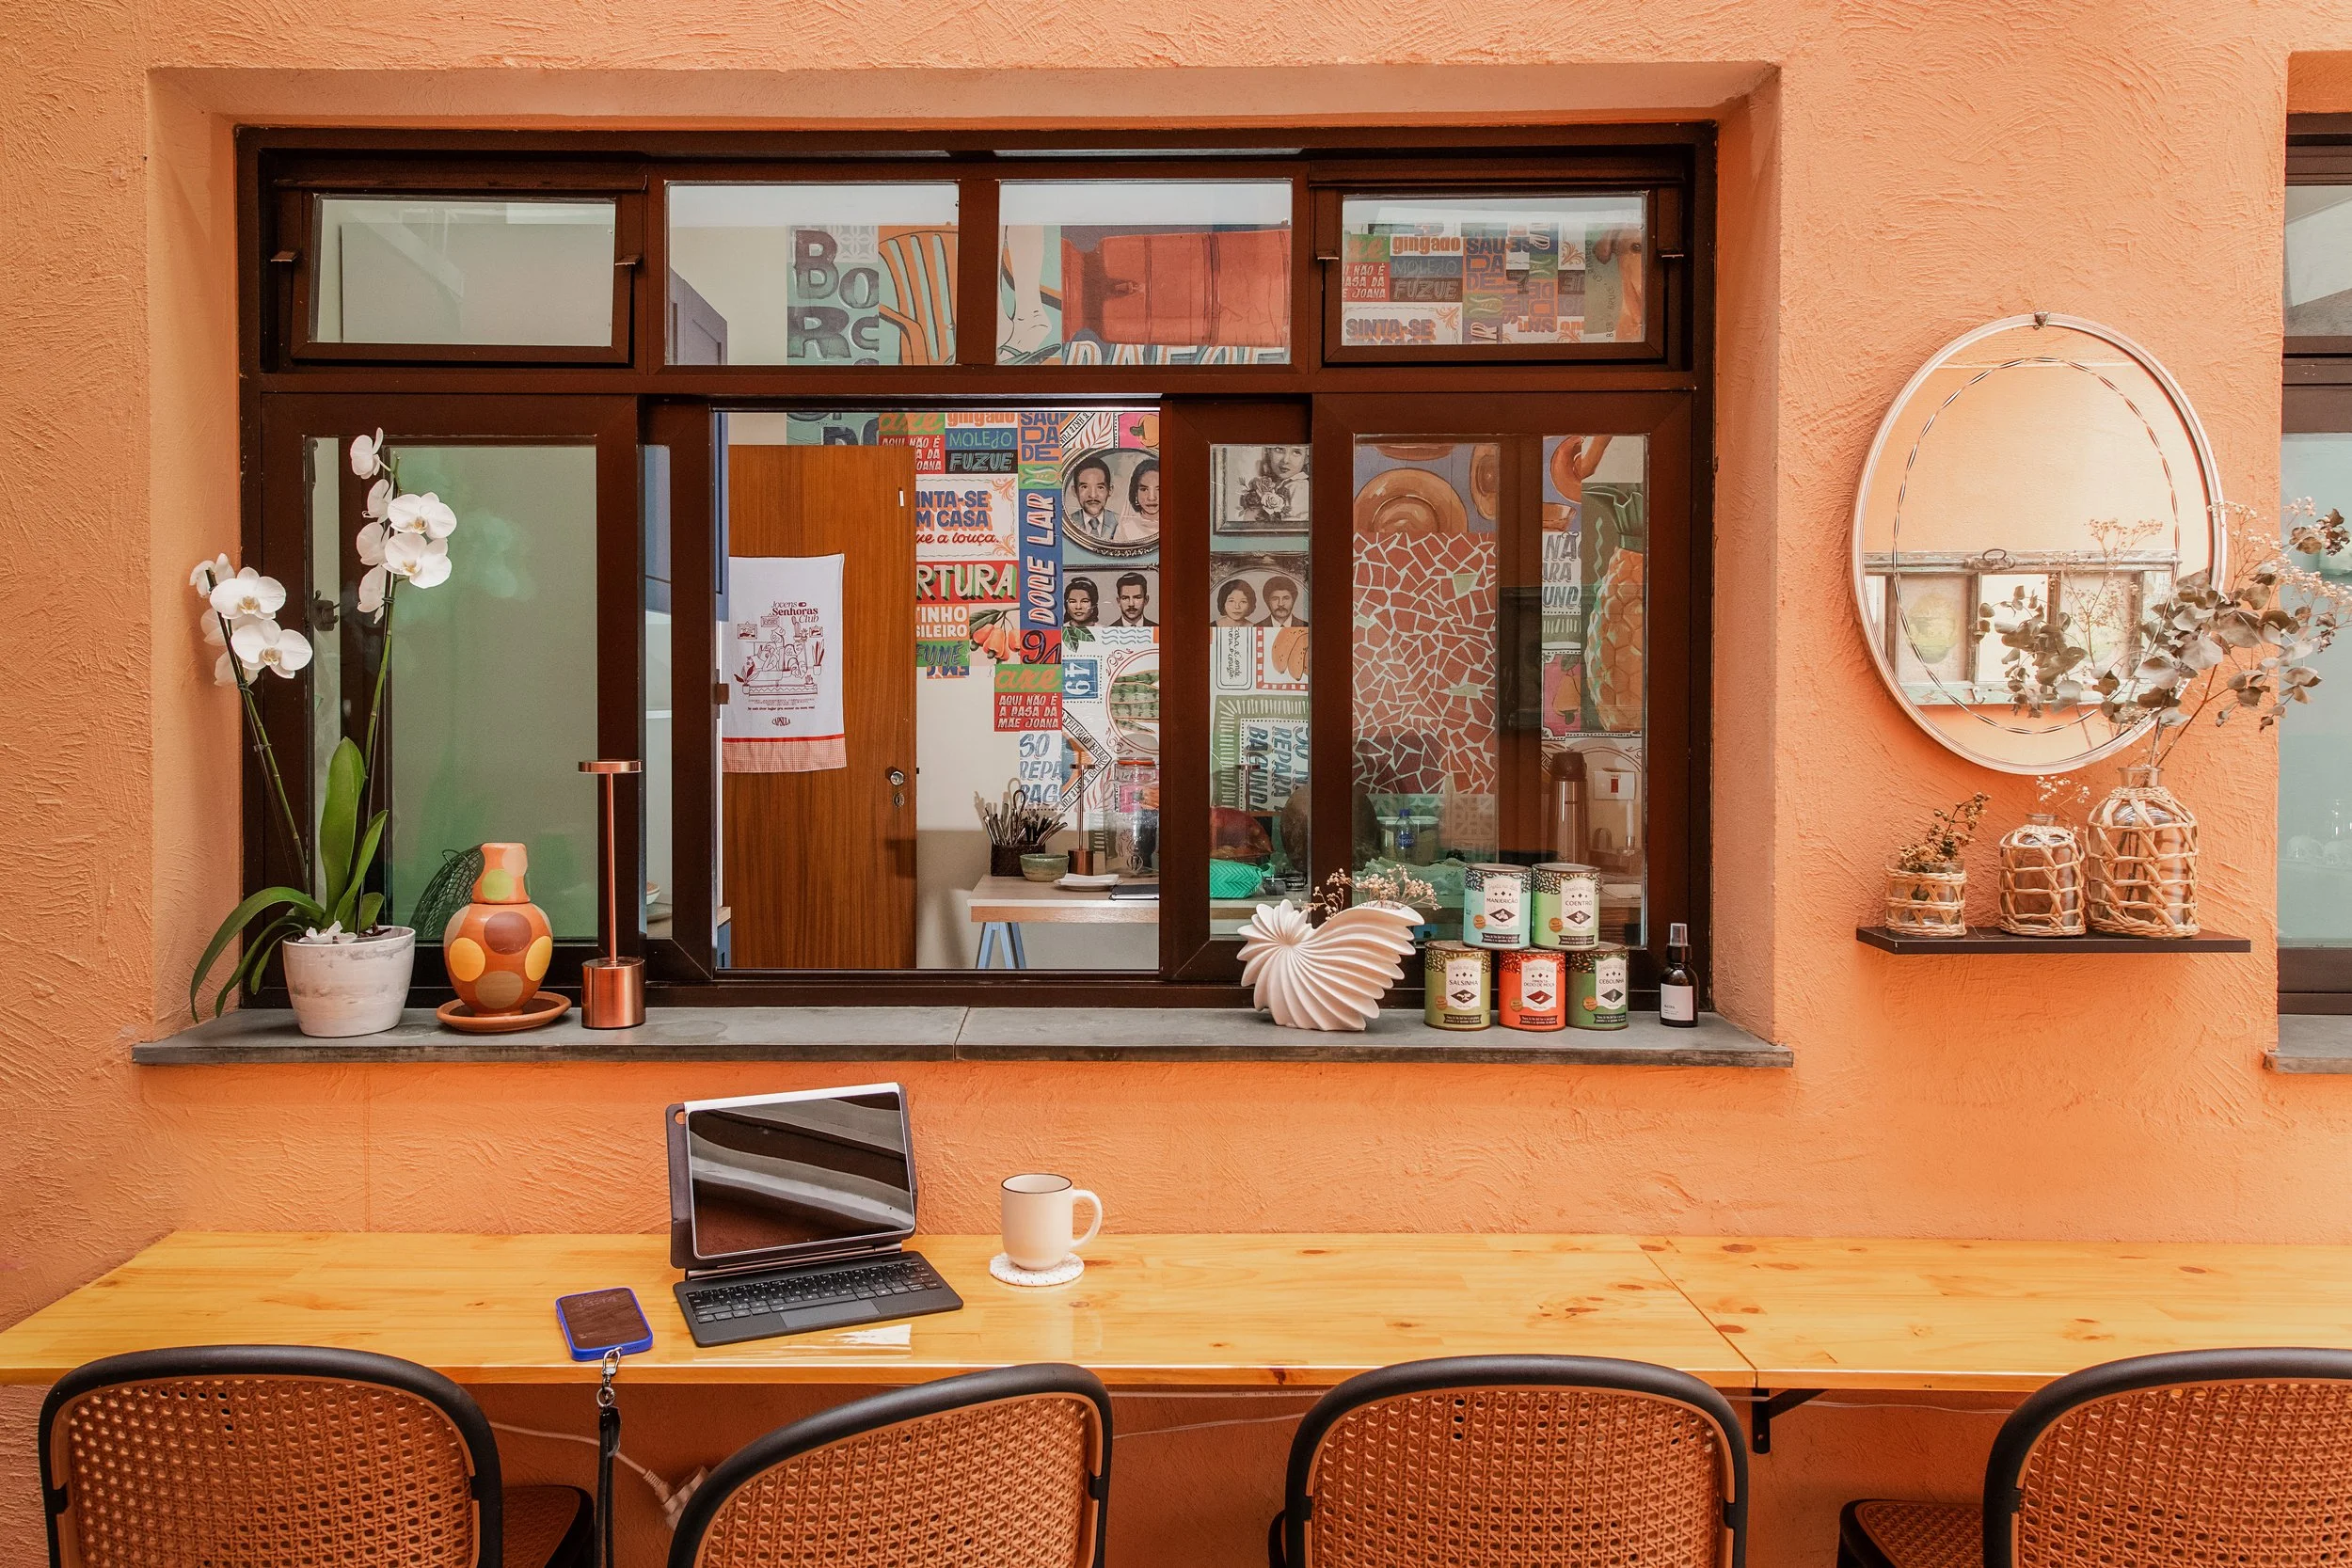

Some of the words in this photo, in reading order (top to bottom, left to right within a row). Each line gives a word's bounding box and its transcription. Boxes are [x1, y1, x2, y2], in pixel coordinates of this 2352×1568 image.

[1392, 235, 1460, 255] gingado
[1343, 277, 1367, 287] ASA
[1352, 288, 1386, 298] JOANA
[1345, 318, 1436, 340] SINTA-SE
[1021, 426, 1059, 444] DA
[1021, 444, 1059, 461] DE
[915, 461, 941, 471] OANA
[937, 511, 991, 530] CASA
[1026, 492, 1056, 547] LAR
[1544, 531, 1581, 561] NÃ
[771, 608, 818, 616] Senhoras
[798, 615, 819, 624] Club
[999, 695, 1023, 705] AQUI
[1026, 694, 1046, 705] NÃO
[1050, 692, 1058, 705] É
[999, 705, 1007, 716] A
[1043, 705, 1057, 716] DA
[998, 716, 1022, 727] MÃE
[1025, 718, 1059, 727] JOANA
[1272, 725, 1292, 798] REPARA
[1020, 784, 1062, 804] BAG
